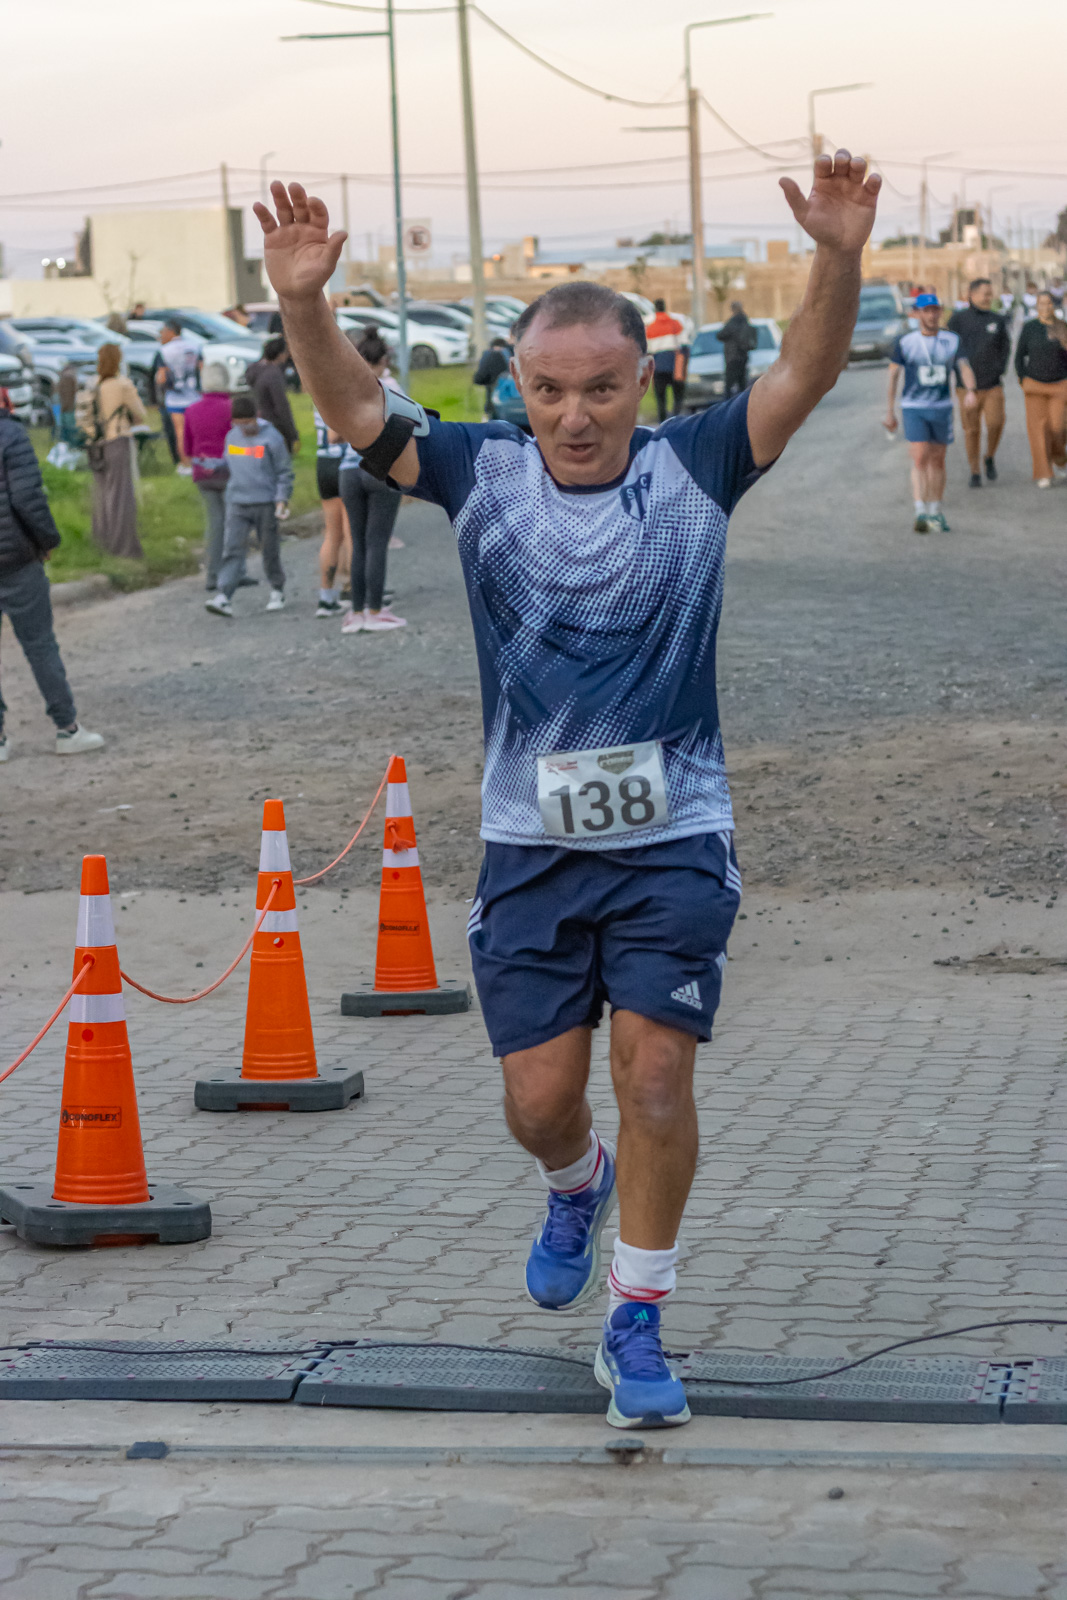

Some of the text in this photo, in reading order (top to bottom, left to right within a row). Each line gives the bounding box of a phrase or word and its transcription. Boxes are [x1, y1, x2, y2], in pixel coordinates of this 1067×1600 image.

[626, 476, 648, 499] S C
[549, 775, 655, 834] 138
[670, 990, 703, 1010] adidas
[69, 1113, 118, 1122] CONOFLEX
